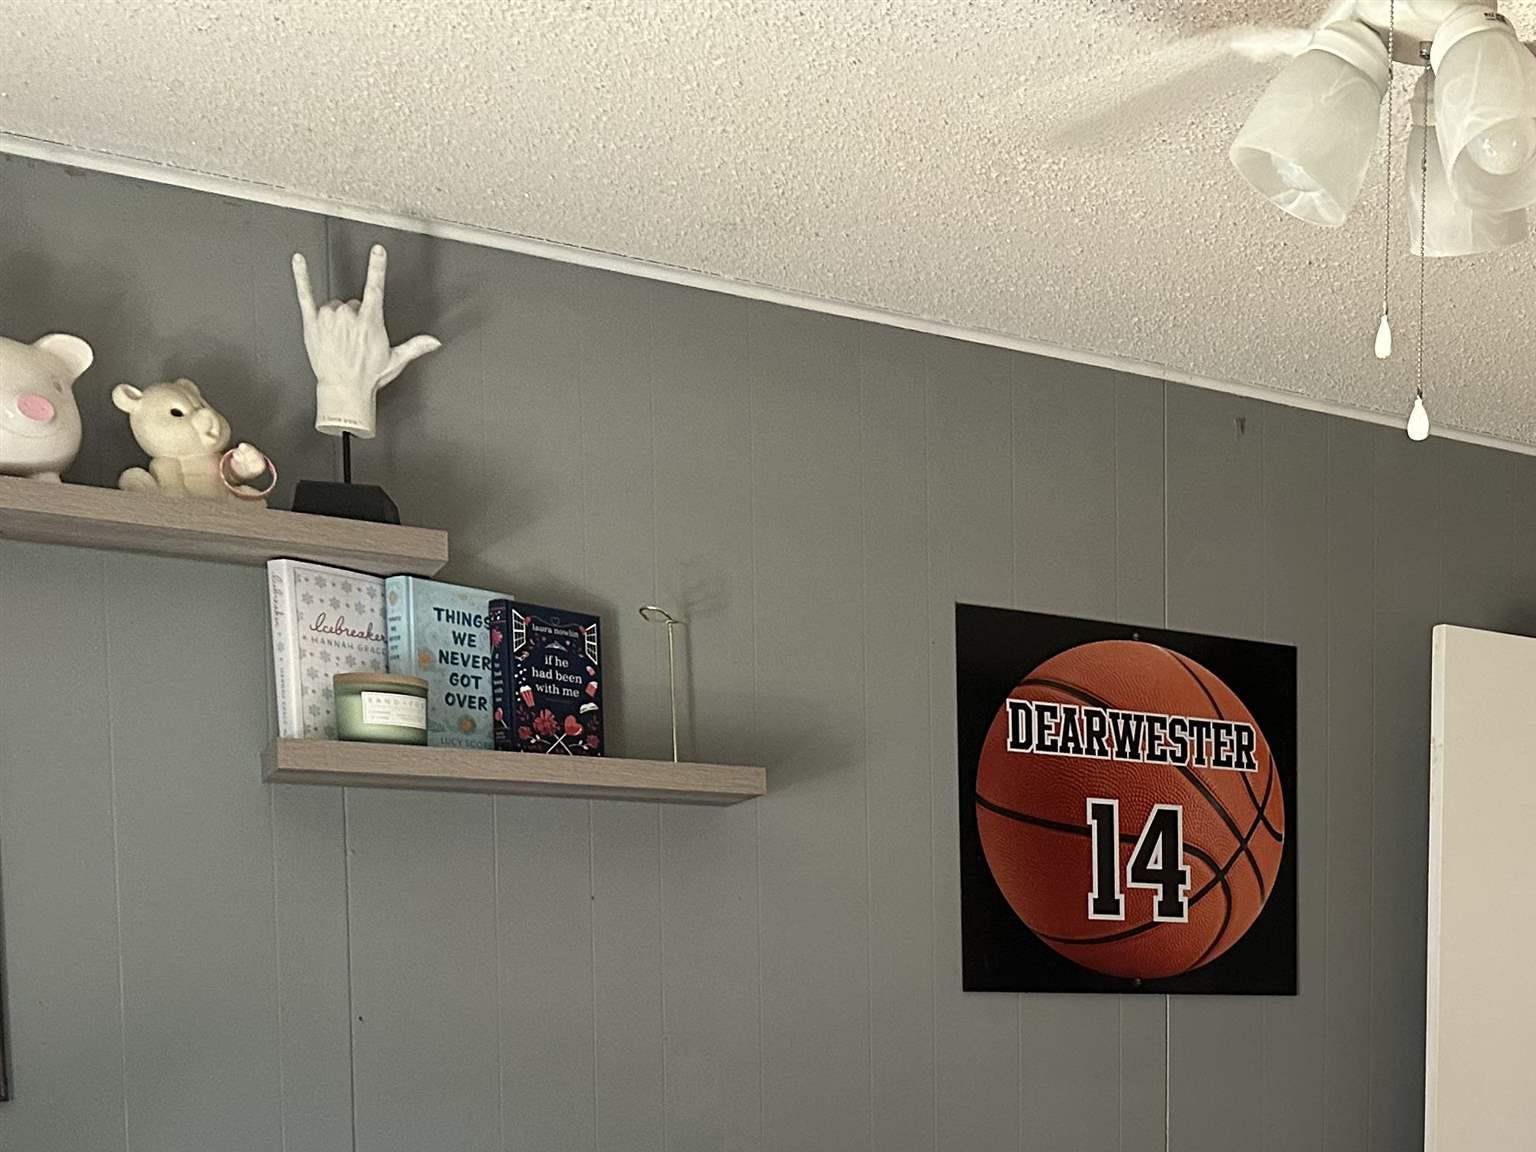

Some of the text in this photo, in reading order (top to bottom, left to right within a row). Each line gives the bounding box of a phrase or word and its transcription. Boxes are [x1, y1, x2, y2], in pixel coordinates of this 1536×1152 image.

[310, 612, 385, 641] Icebreaker
[433, 607, 491, 630] THINGS
[452, 630, 477, 648] WE
[439, 649, 492, 671] NEVER
[545, 655, 569, 668] if he
[449, 673, 482, 690] GOT
[532, 667, 582, 684] had been
[535, 684, 580, 698] with me
[444, 692, 488, 711] OVER
[1006, 698, 1258, 773] DEARWESTER
[1086, 797, 1191, 923] 14
